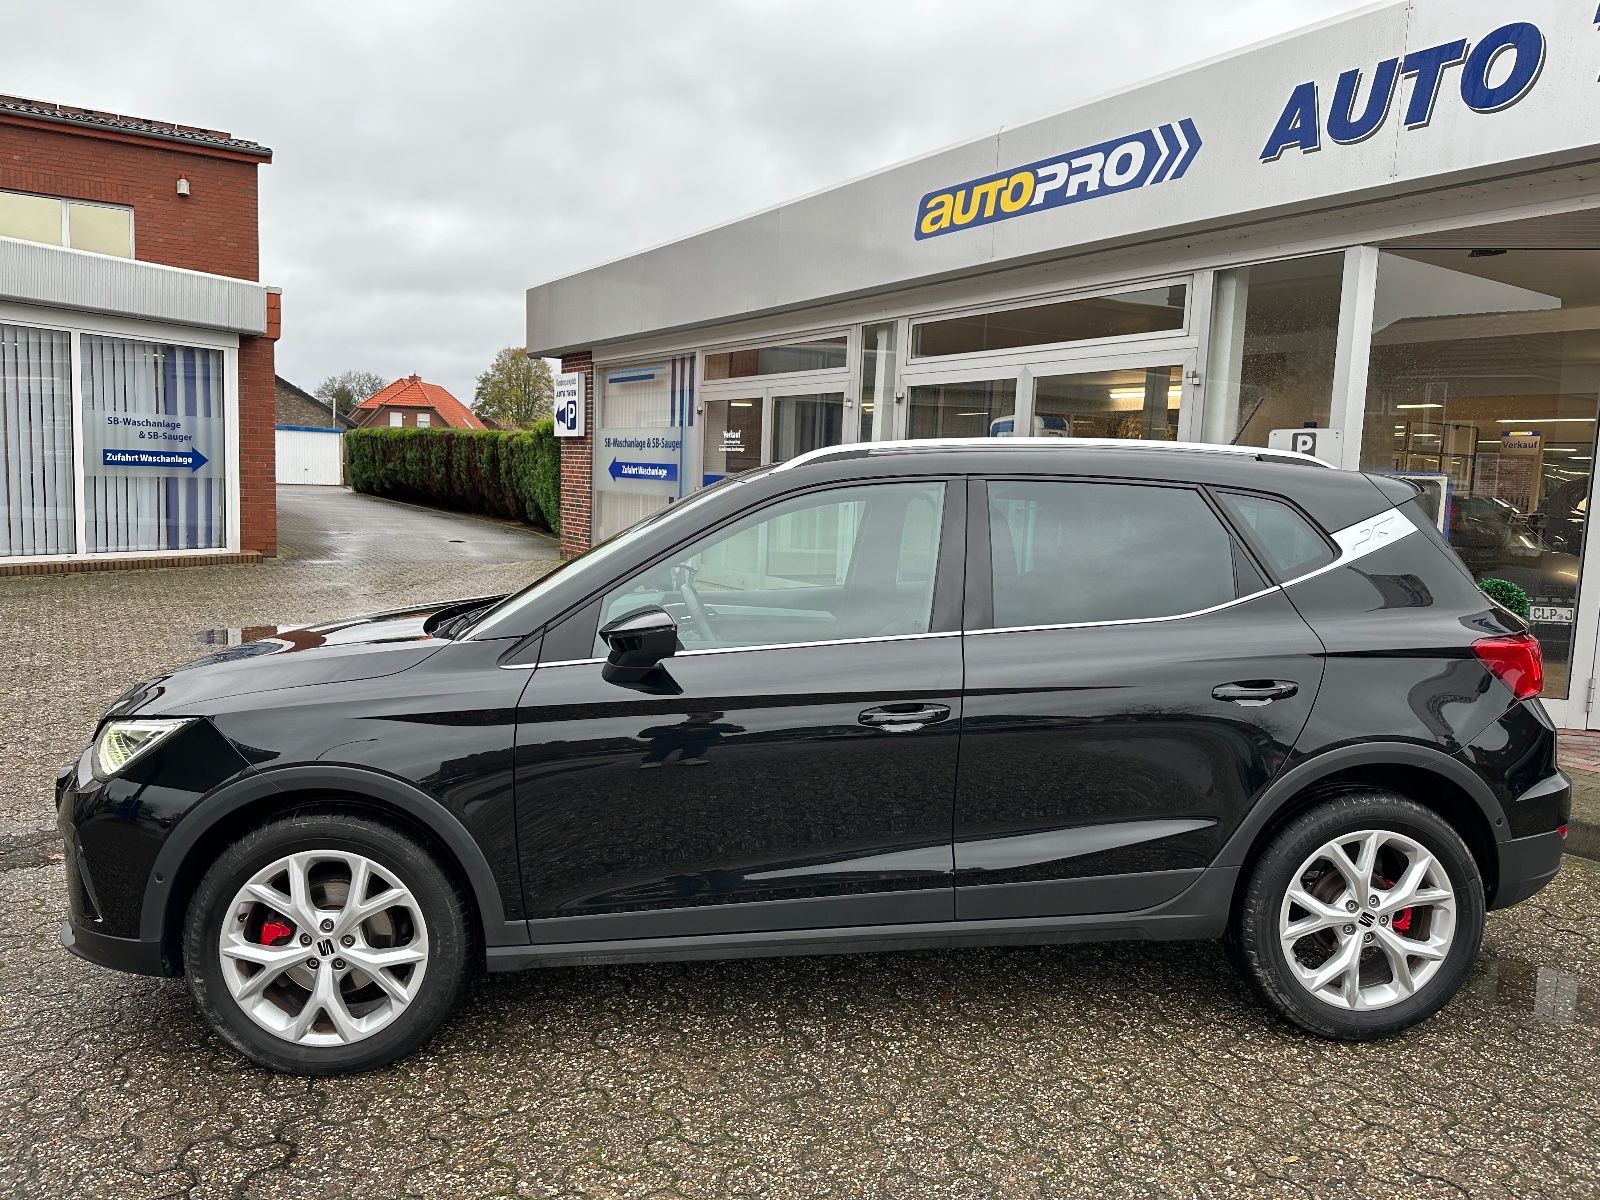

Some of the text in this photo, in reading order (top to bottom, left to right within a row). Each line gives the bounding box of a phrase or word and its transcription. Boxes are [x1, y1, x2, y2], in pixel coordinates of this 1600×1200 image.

[1260, 22, 1546, 162] AUTO
[567, 403, 576, 427] P
[107, 416, 181, 430] SB-Waschanlage
[138, 431, 193, 443] & SB-Sauger
[722, 429, 741, 439] Verkauf
[604, 437, 682, 451] SB-Waschanlage & SB-Sauger
[1503, 440, 1538, 449] Verkauf
[106, 453, 193, 465] Zufahrt Waschanlage
[621, 465, 668, 478] Zufahrt Waschanlage
[1533, 607, 1557, 620] CLP
